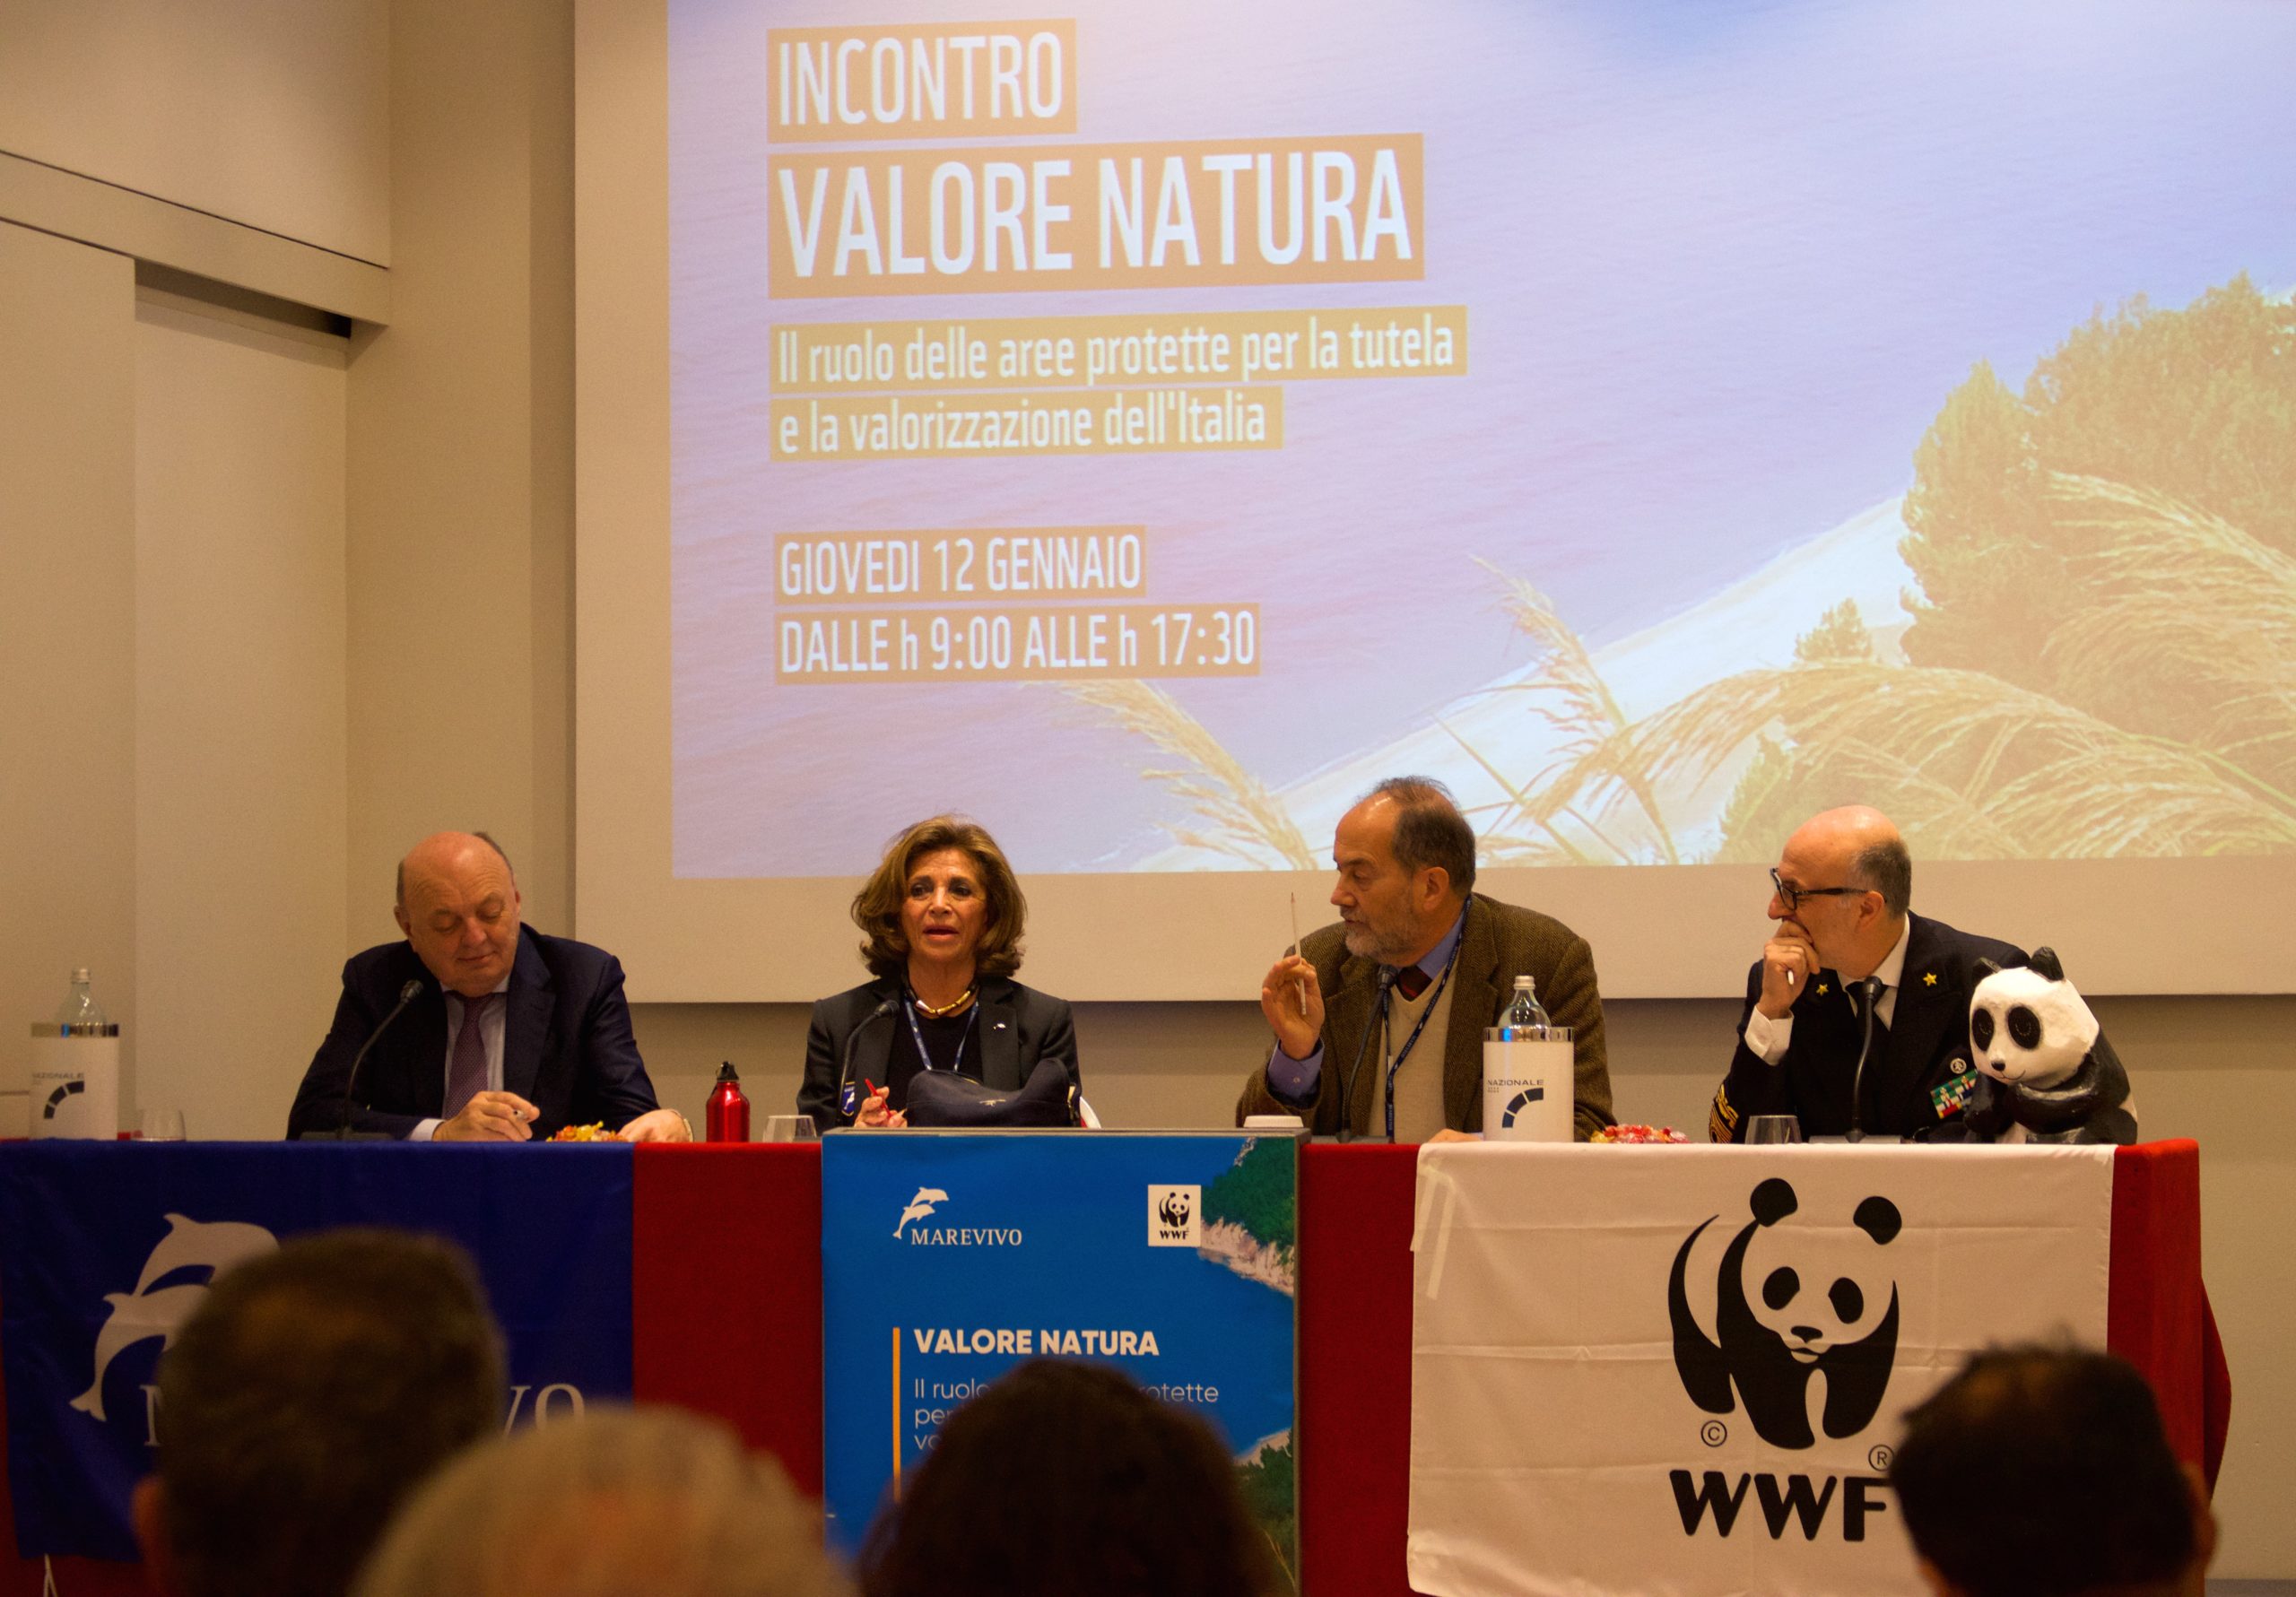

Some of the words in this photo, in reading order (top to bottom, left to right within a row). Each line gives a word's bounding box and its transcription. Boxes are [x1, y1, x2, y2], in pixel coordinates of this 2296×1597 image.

[778, 31, 1062, 126] INCONTRO
[778, 160, 1074, 277] VALORE
[1098, 148, 1413, 269] NATURA
[778, 330, 798, 384] Il
[809, 328, 894, 383] ruolo
[904, 325, 987, 379] delle
[998, 334, 1075, 378] aree
[1086, 326, 1230, 386] protette
[1241, 330, 1296, 382] per
[1309, 316, 1340, 369] la
[1349, 313, 1454, 368] tutela
[778, 414, 799, 455] e
[810, 399, 839, 453] la
[848, 397, 1092, 453] valorizzazione
[1104, 390, 1266, 447] dell'Italia
[780, 539, 920, 596] GIOVEDI
[933, 538, 974, 594] 12
[986, 534, 1142, 594] GENNAIO
[780, 618, 890, 674] DALLE
[900, 617, 918, 672] h
[930, 615, 1013, 671] 9:00
[1022, 613, 1109, 670] ALLE
[1118, 612, 1138, 666] h
[1149, 610, 1256, 666] 17:30
[1487, 1079, 1544, 1087] NAZIONALE
[910, 1228, 1023, 1247] MAREVIVO
[1160, 1230, 1189, 1240] WWF
[914, 1329, 1033, 1356] VALORE
[1040, 1329, 1161, 1357] NATURA
[915, 1377, 925, 1400] Il
[1137, 1383, 1219, 1402] otette
[1669, 1469, 1894, 1542] WWF
